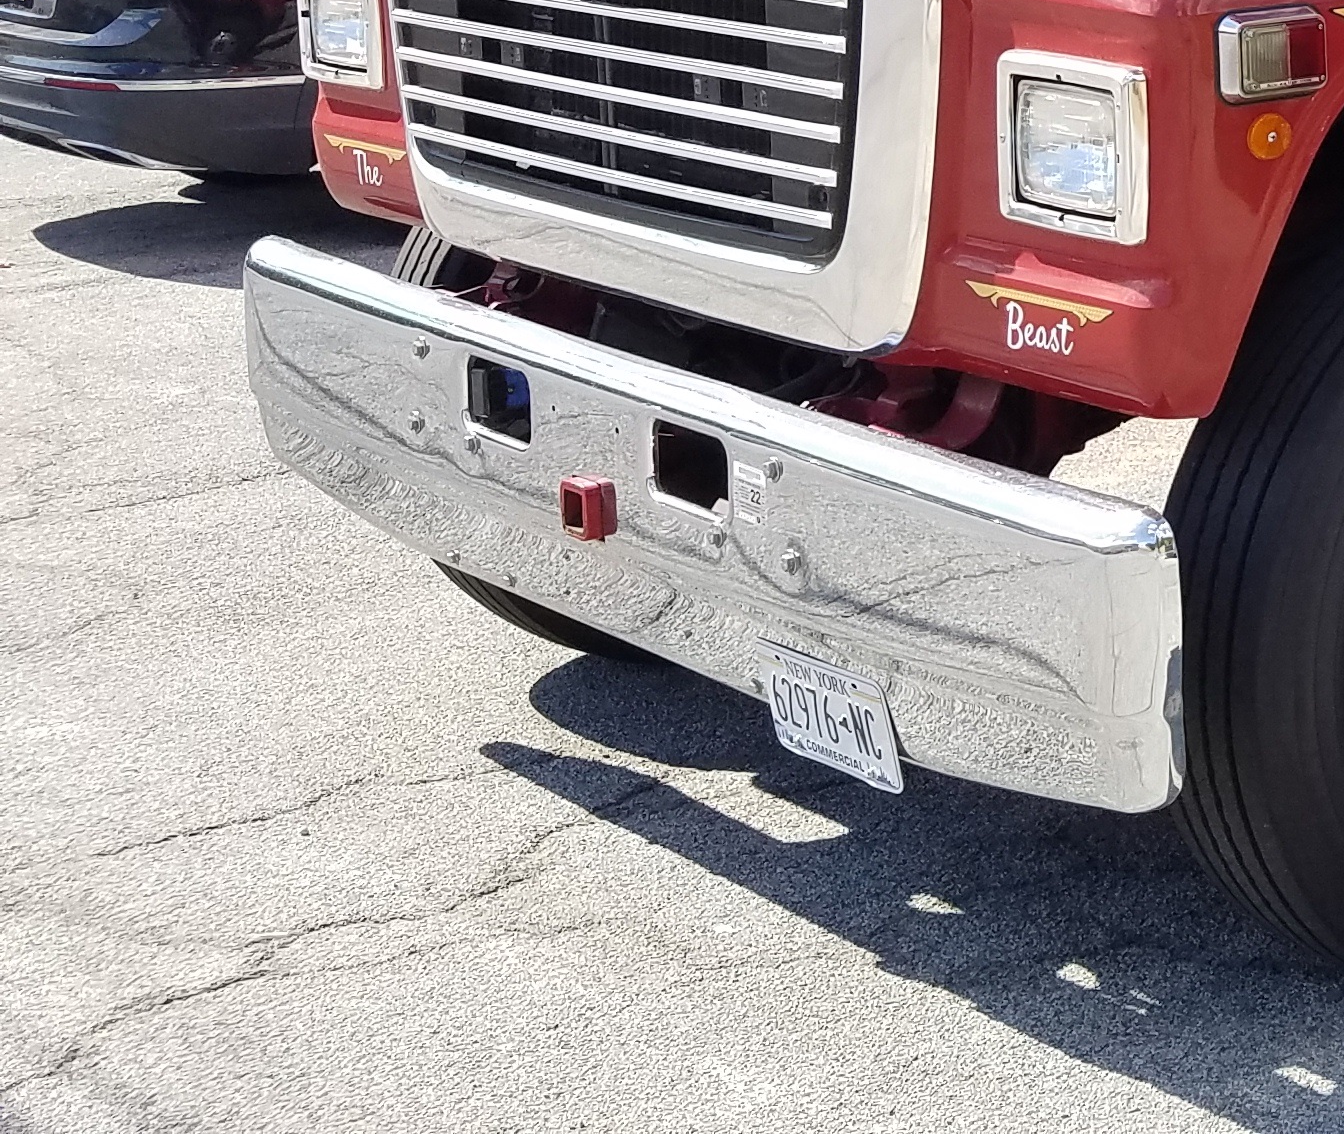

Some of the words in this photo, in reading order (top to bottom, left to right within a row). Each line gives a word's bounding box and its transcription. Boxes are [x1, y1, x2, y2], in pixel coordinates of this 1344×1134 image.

[352, 148, 384, 187] The
[1005, 300, 1074, 356] Beast
[750, 489, 761, 505] 22
[782, 658, 812, 684] NEW
[813, 670, 851, 698] YORK
[805, 738, 866, 773] COMMERCIAL
